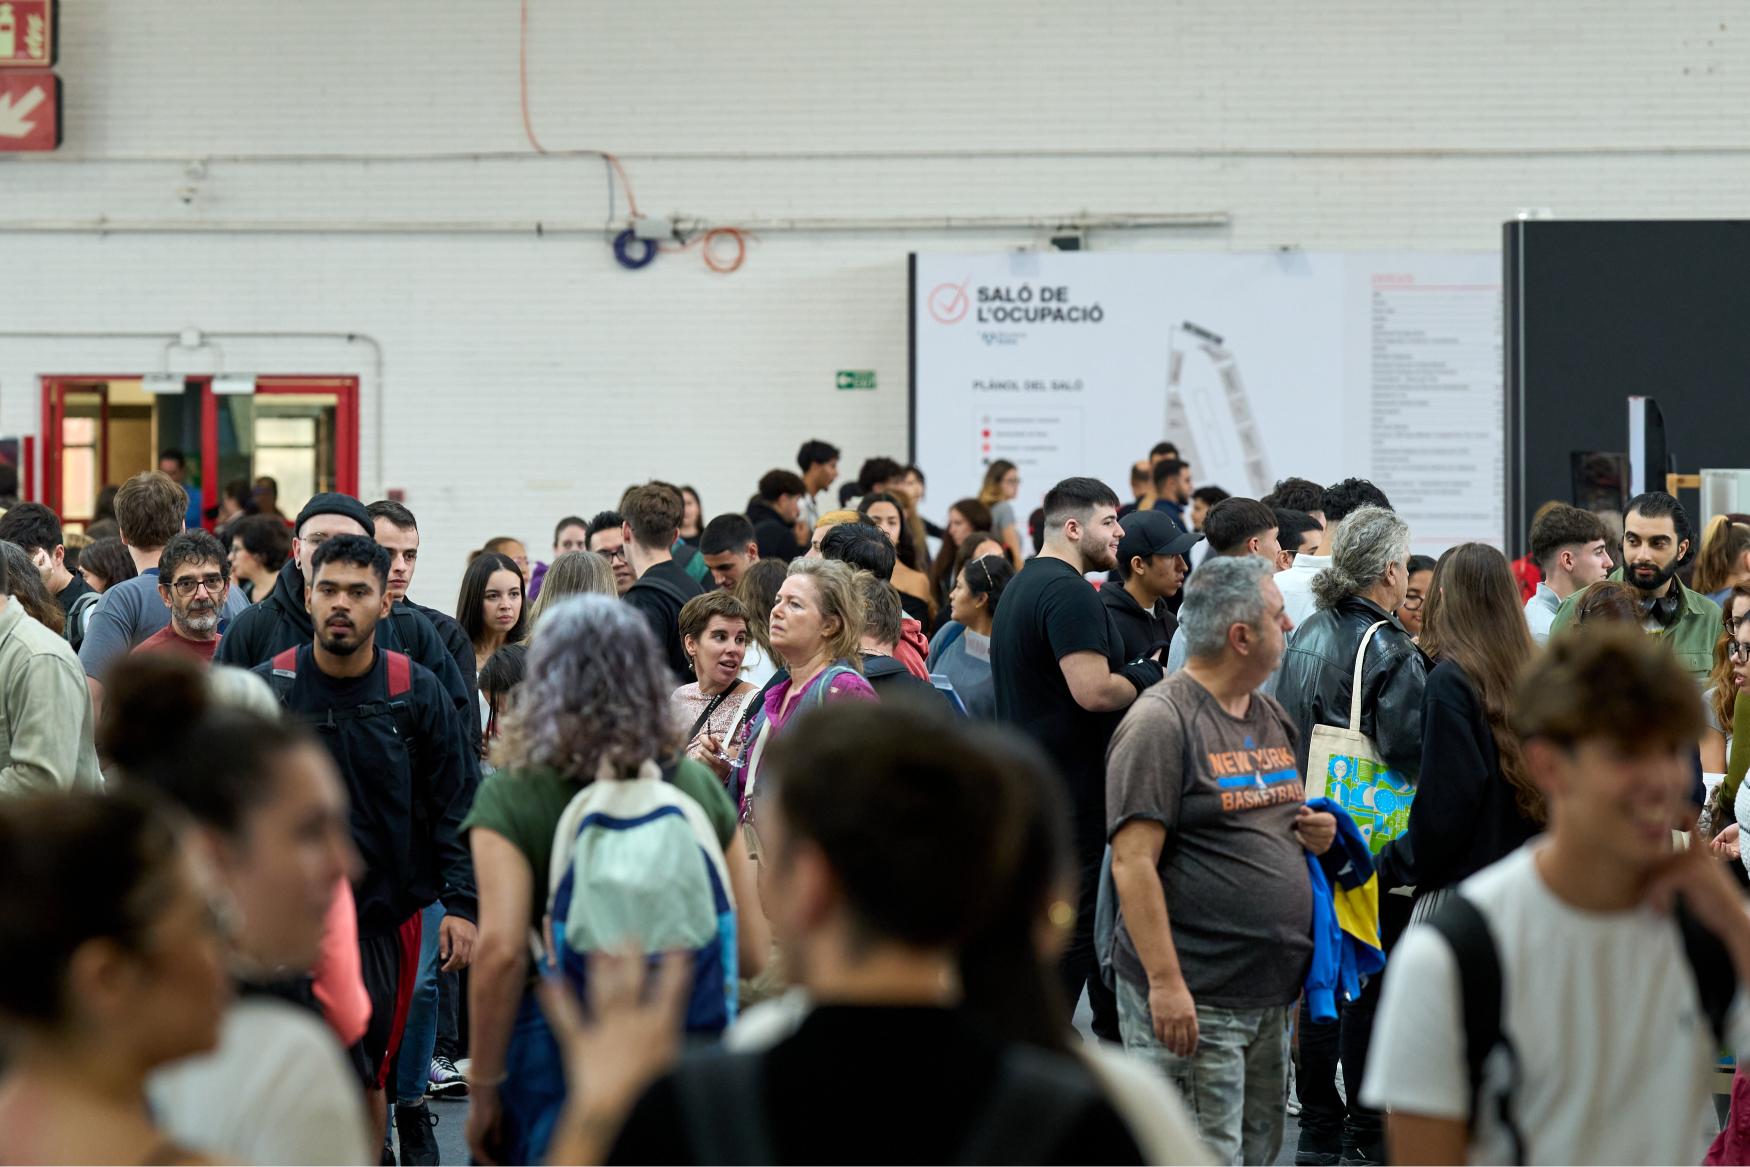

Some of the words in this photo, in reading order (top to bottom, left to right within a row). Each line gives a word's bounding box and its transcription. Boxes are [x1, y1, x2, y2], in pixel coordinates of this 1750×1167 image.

[977, 282, 1033, 302] SALÓ
[1040, 286, 1069, 302] DE
[977, 302, 1104, 323] L'OCUPACIÓ
[1208, 751, 1253, 774] NEW
